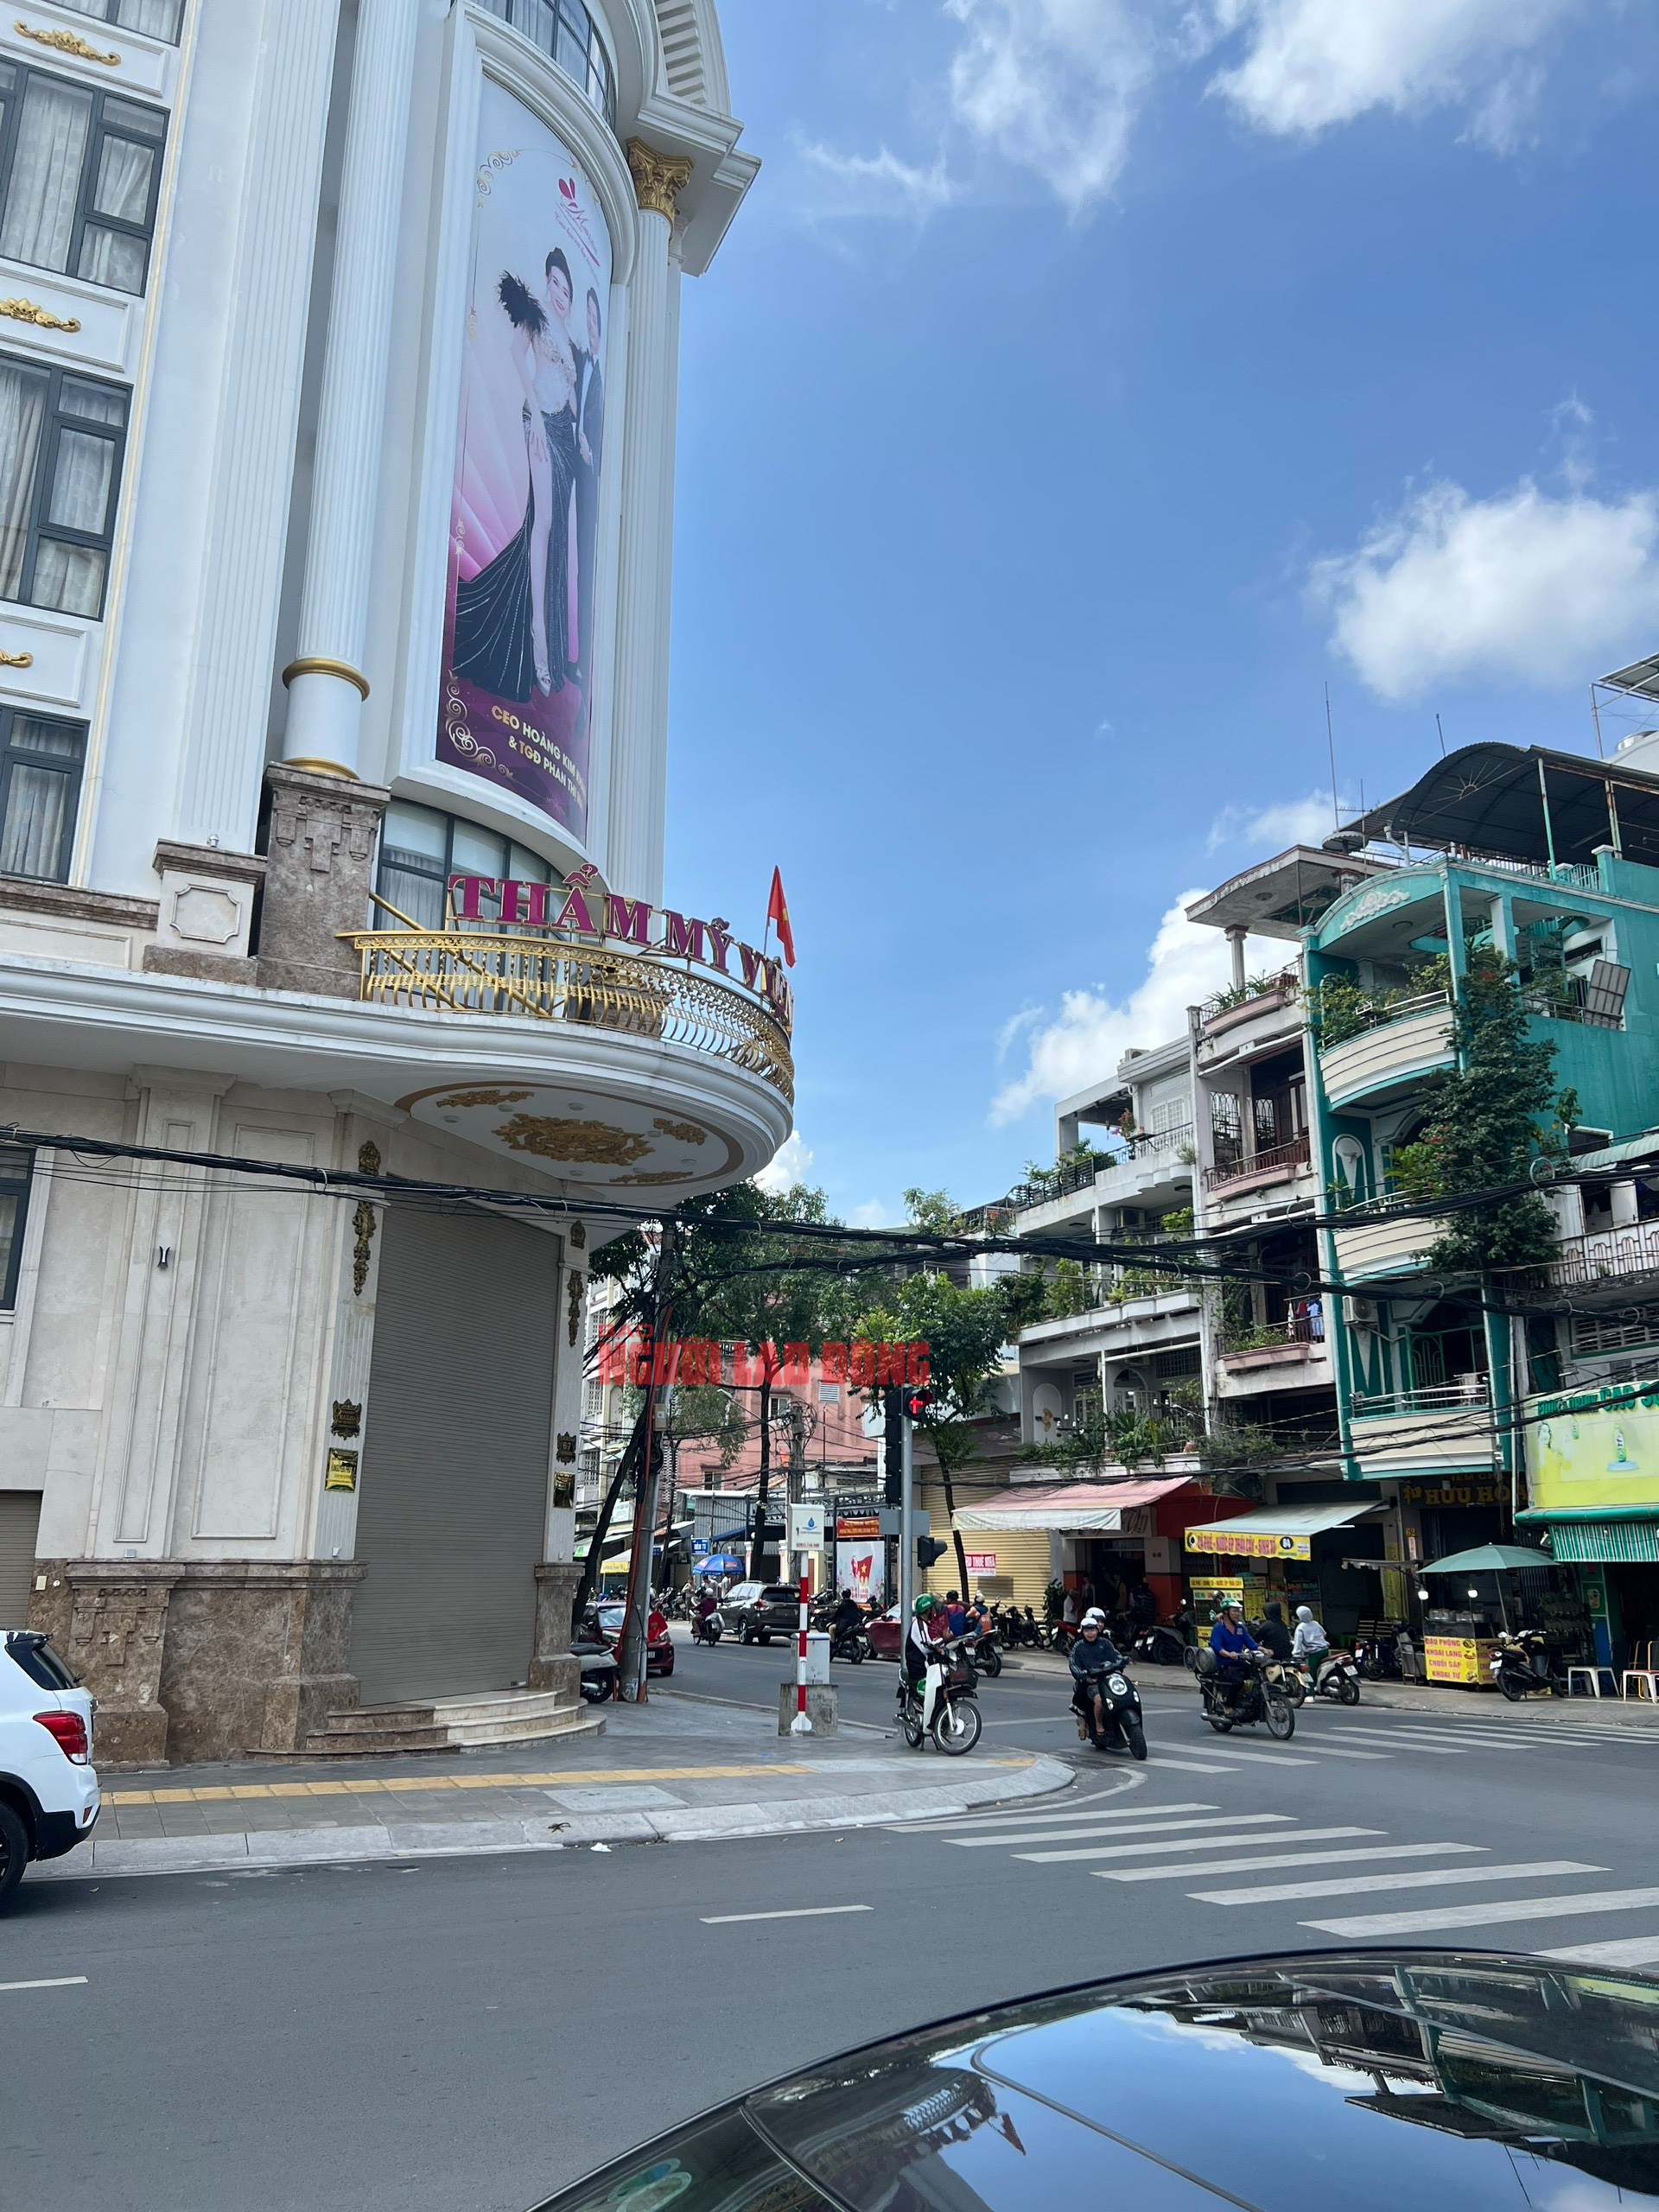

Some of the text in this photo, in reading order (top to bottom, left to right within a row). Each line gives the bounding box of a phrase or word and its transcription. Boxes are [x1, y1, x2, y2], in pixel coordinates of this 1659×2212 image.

[492, 705, 575, 777] CEO HOÀNG KIM
[508, 735, 518, 750] &
[518, 740, 542, 765] TGĐ
[543, 757, 566, 786] PHAN
[448, 863, 654, 946] THẨM
[662, 908, 735, 975] MỸ
[1405, 1527, 1416, 1537] 62
